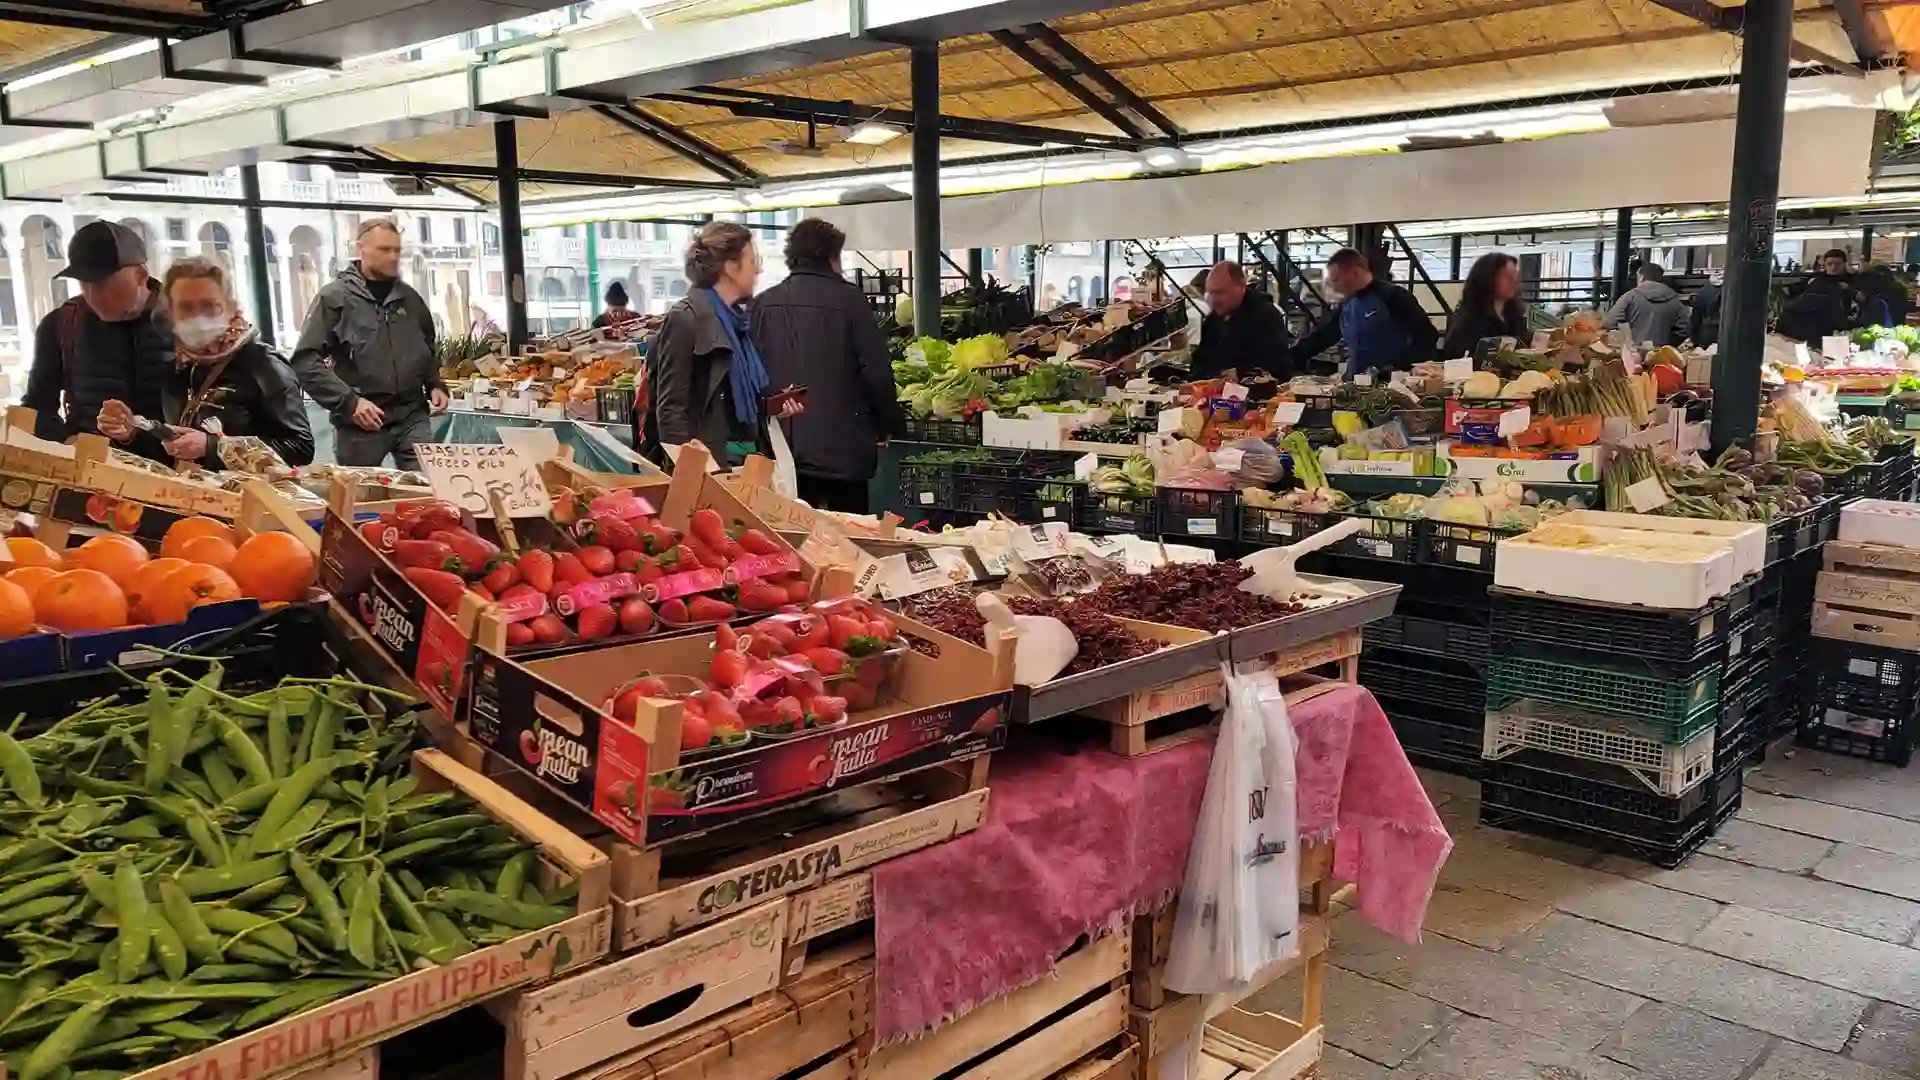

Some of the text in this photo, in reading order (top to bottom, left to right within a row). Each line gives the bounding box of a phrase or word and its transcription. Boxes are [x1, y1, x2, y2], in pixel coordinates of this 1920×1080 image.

[419, 444, 519, 458] BASILICATA
[859, 563, 878, 586] EURO
[538, 727, 592, 768] mean
[830, 723, 889, 762] mean
[535, 743, 582, 785] frutta
[826, 742, 880, 788] frutta
[697, 844, 842, 915] COFERASTA
[237, 1001, 380, 1079] FRUTTA
[391, 954, 498, 1022] FILIPPI
[501, 957, 530, 980] SRL
